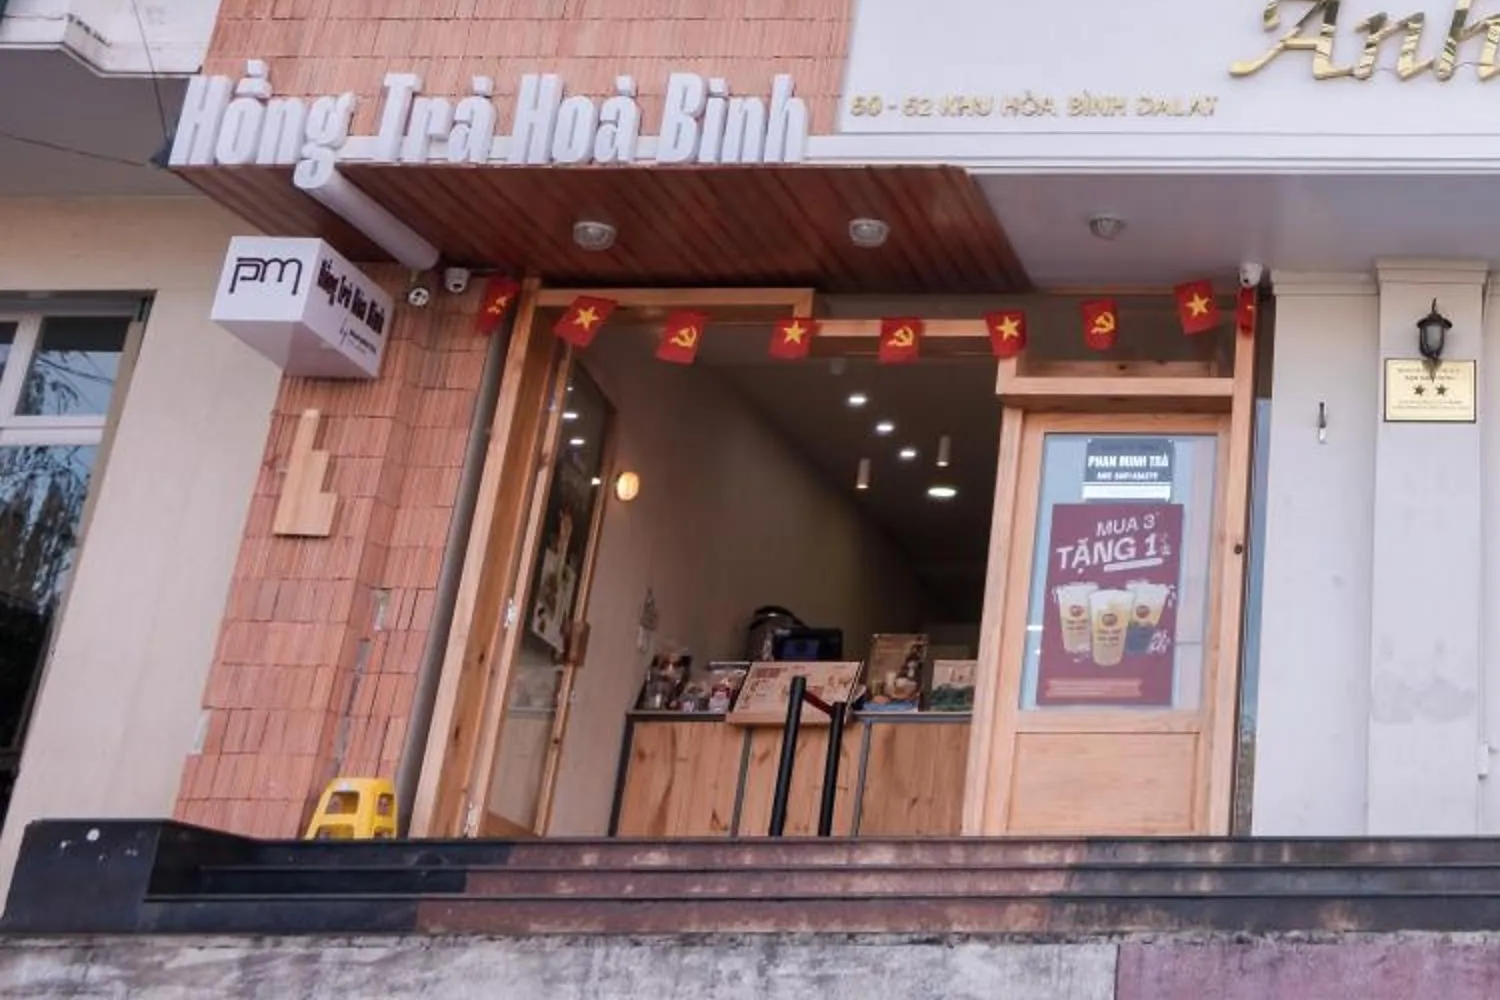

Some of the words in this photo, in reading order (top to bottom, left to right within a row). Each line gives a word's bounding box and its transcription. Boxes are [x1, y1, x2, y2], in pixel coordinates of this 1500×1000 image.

[373, 73, 497, 163] Trà
[655, 73, 809, 164] Bình
[940, 95, 994, 117] KHU
[1096, 517, 1139, 537] MUA
[1143, 513, 1155, 529] 3
[1056, 537, 1137, 575] TẶNG
[1144, 533, 1158, 557] 1
